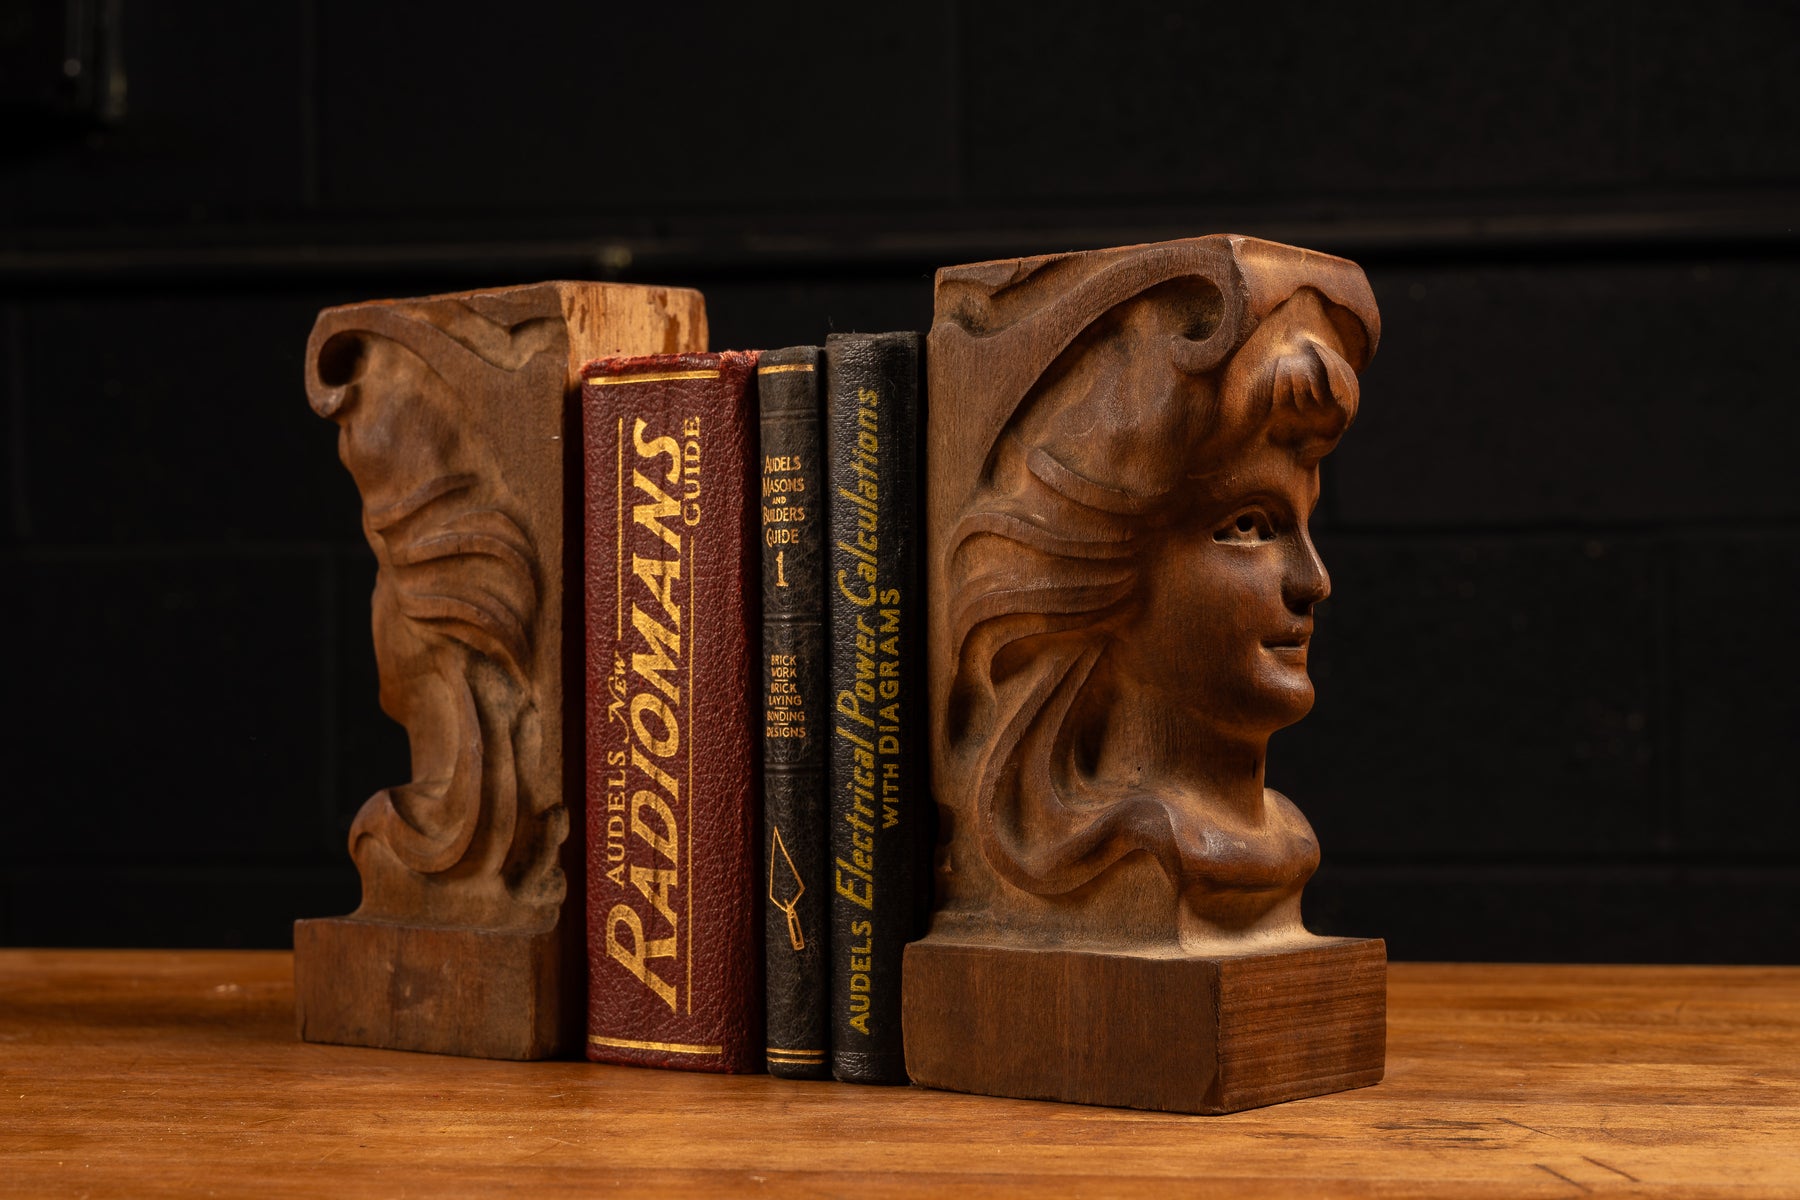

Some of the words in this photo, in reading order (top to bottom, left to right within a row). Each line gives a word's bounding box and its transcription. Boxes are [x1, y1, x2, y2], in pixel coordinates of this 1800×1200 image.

[683, 416, 701, 526] GUIDE
[764, 455, 801, 474] AUDELS
[762, 477, 805, 497] MASONS
[837, 386, 878, 607] Calculations
[772, 496, 787, 505] AND
[763, 507, 805, 526] BUILDERS
[766, 528, 799, 548] GUIDE
[771, 654, 797, 667] BRICK
[771, 667, 797, 678] WORK
[836, 614, 876, 729] Power
[878, 588, 900, 755] DIAGRAMS
[770, 682, 797, 694] BRICK
[768, 695, 802, 706] LAYING
[606, 417, 681, 1015] RADIOMANS
[766, 711, 805, 722] BONDING
[766, 726, 806, 738] DESIGNS
[882, 763, 900, 830] WITH
[605, 750, 626, 890] AUDELS
[836, 726, 875, 911] Electrical
[850, 920, 873, 1035] AUDELS
